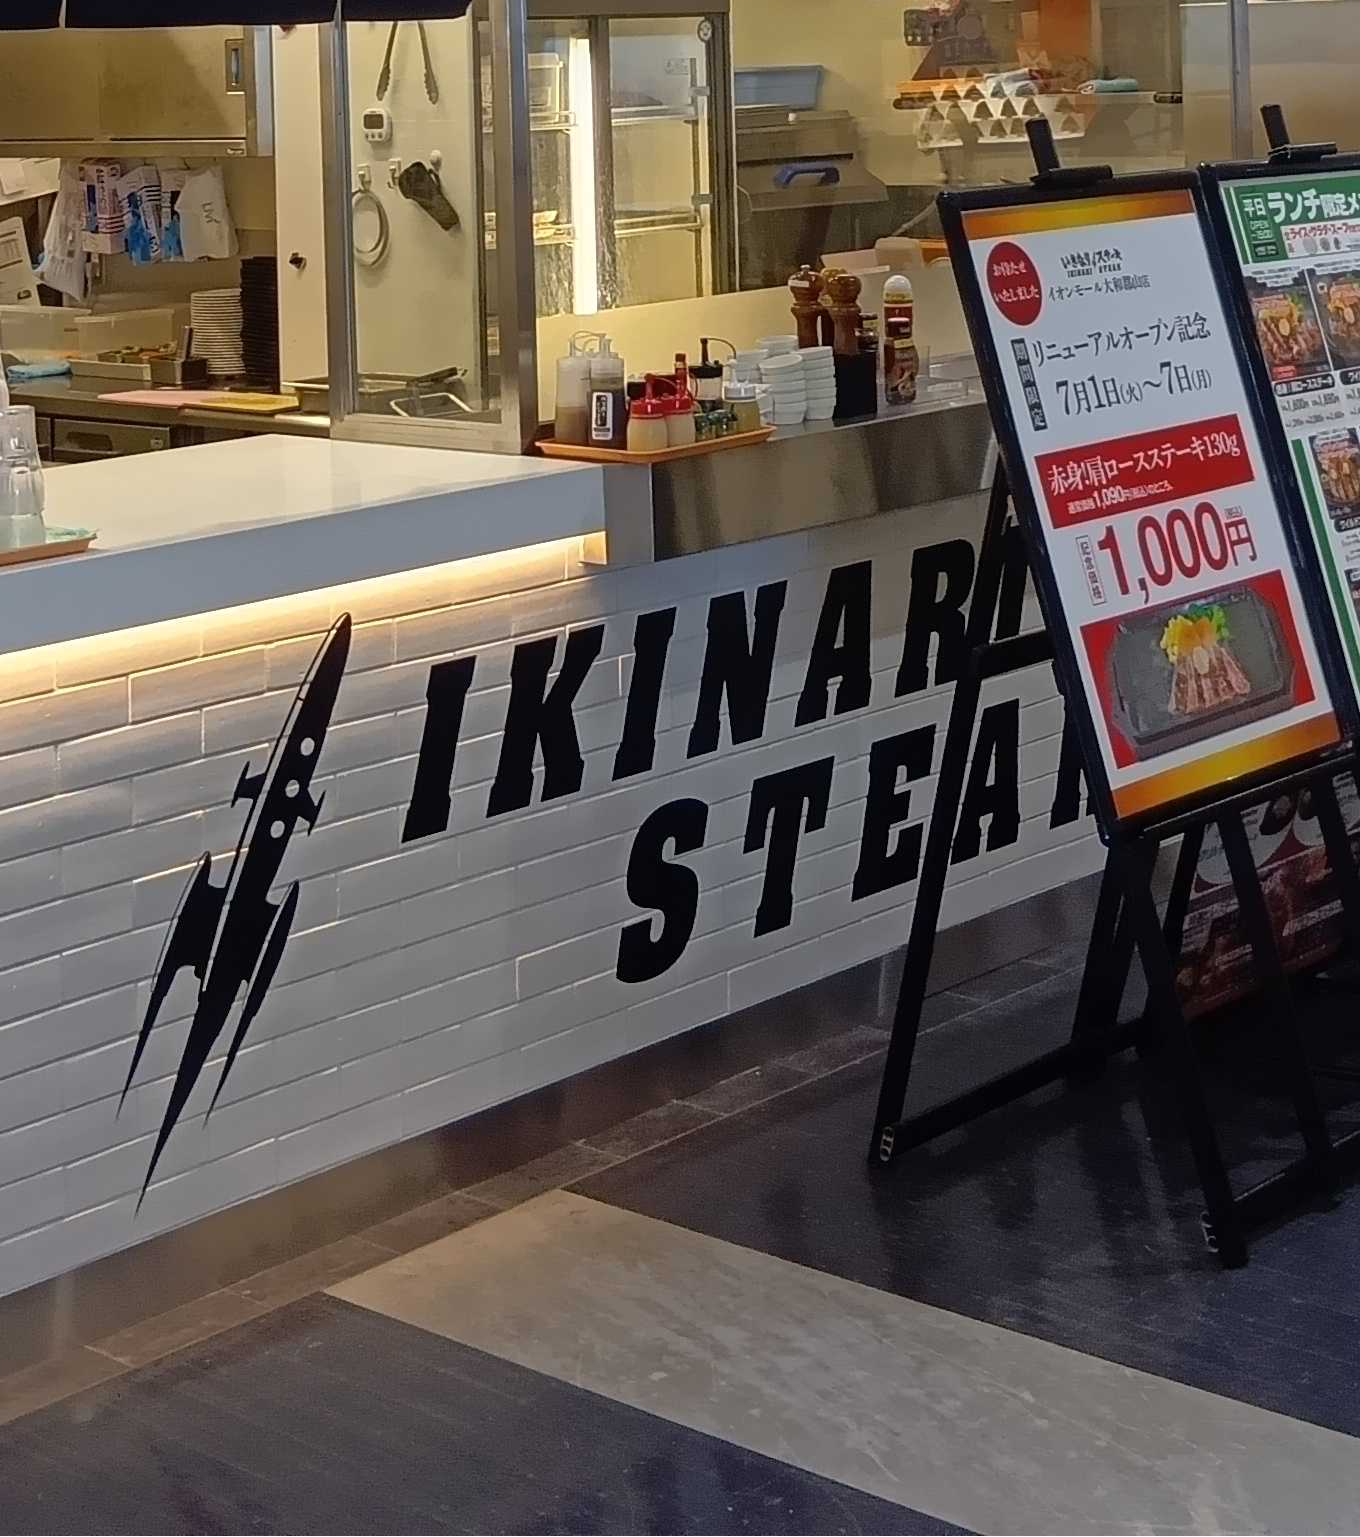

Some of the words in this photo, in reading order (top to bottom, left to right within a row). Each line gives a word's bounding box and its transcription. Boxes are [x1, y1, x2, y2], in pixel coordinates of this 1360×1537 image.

[1242, 196, 1267, 217] 平日
[991, 261, 1029, 278] お待たせ
[993, 286, 1039, 303] いたしました
[1031, 311, 1213, 367] リニューアルオープン記念
[1097, 500, 1258, 605] 1,000円
